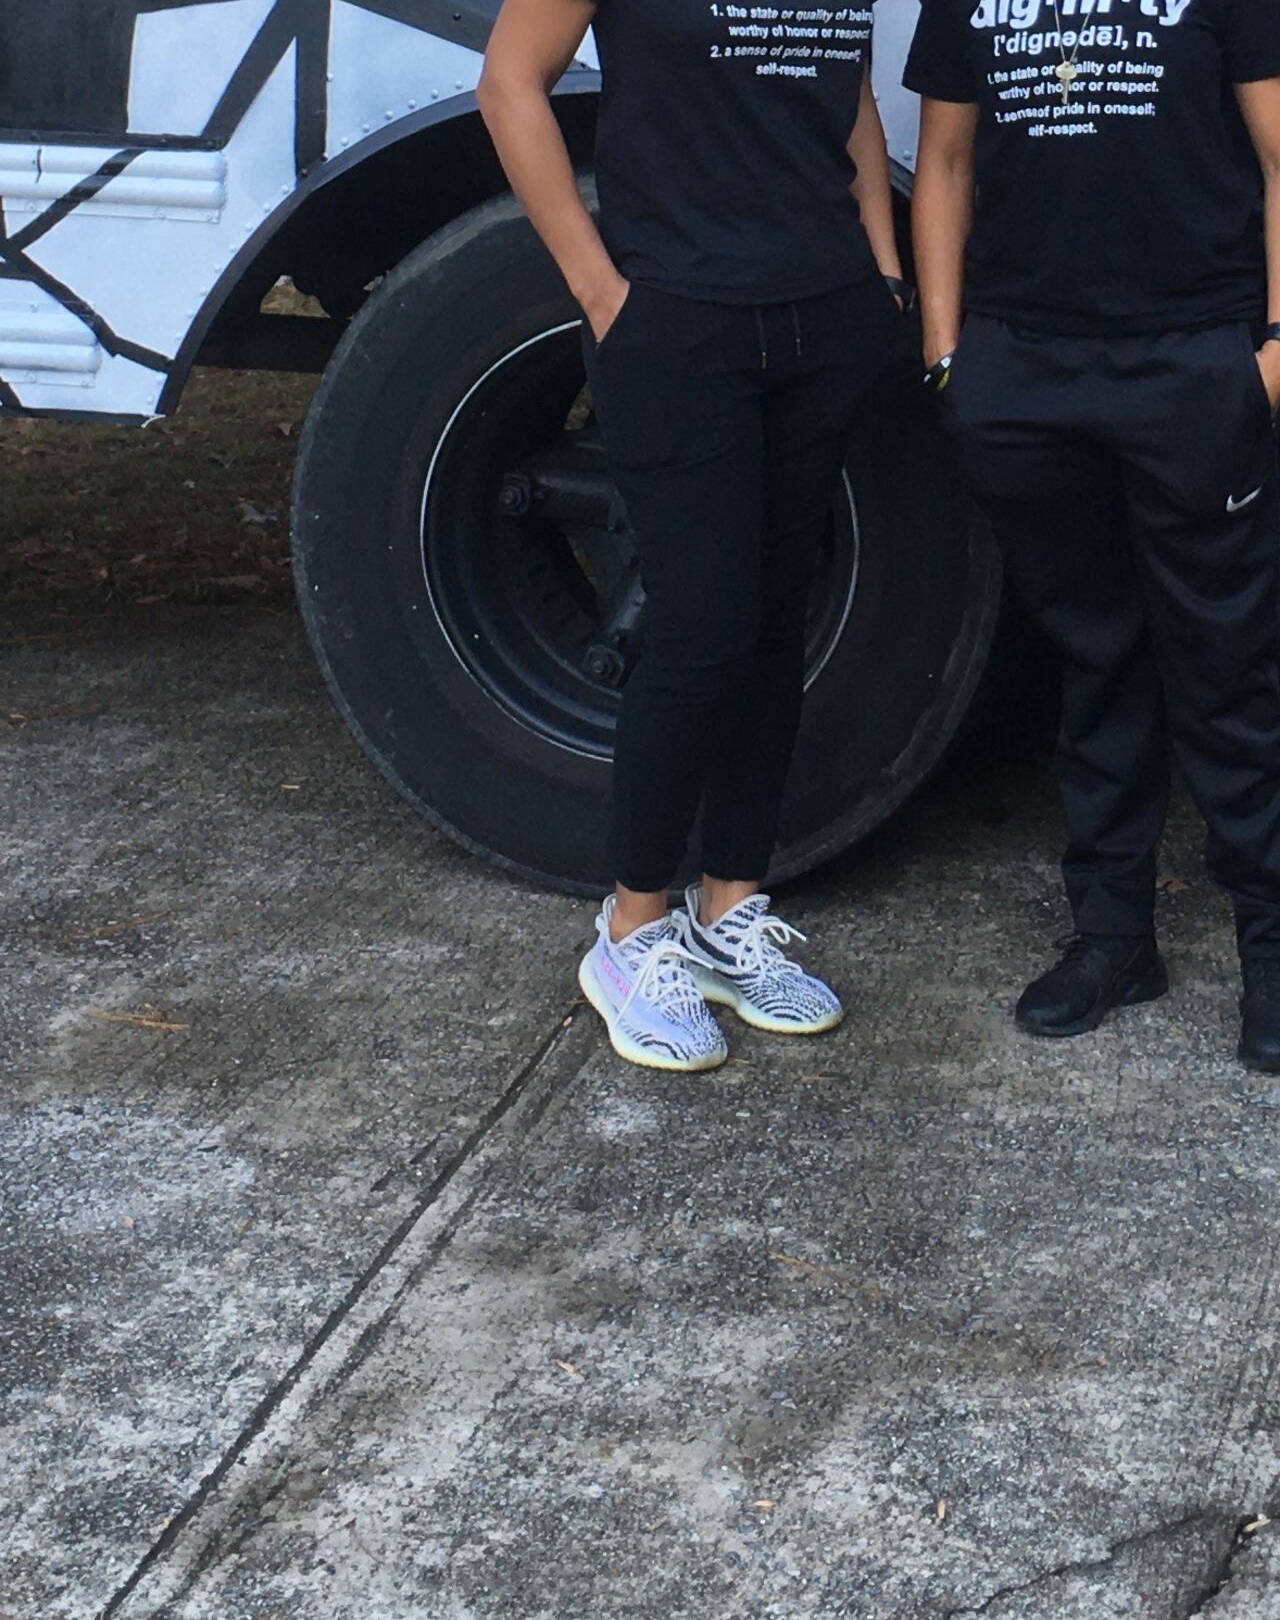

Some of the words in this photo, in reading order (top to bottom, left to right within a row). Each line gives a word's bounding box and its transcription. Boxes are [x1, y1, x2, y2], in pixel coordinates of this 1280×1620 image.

[710, 4, 724, 17] 1.
[726, 5, 748, 18] the
[750, 7, 779, 20] state
[781, 9, 794, 19] or
[796, 8, 833, 23] quality
[835, 8, 848, 21] of
[728, 24, 769, 39] worthy
[772, 25, 783, 36] of
[784, 25, 819, 38] honor
[821, 27, 833, 38] or
[1136, 31, 1158, 48] n.
[710, 45, 722, 58] 2.
[724, 46, 732, 57] a
[734, 45, 768, 56] sense
[770, 45, 783, 56] of
[782, 46, 811, 59] pride
[812, 46, 823, 57] in
[755, 62, 818, 78] self-respect.
[1010, 66, 1039, 81] state
[1041, 65, 1056, 76] or
[1070, 61, 1104, 76] ality
[1107, 61, 1124, 74] of
[1125, 61, 1164, 78] being
[1033, 82, 1045, 96] of
[1088, 81, 1104, 91] or
[1106, 81, 1160, 95] respect.
[1037, 105, 1050, 118] of
[1053, 101, 1085, 119] pride
[1087, 101, 1100, 114] in
[1104, 102, 1156, 116] oneself;
